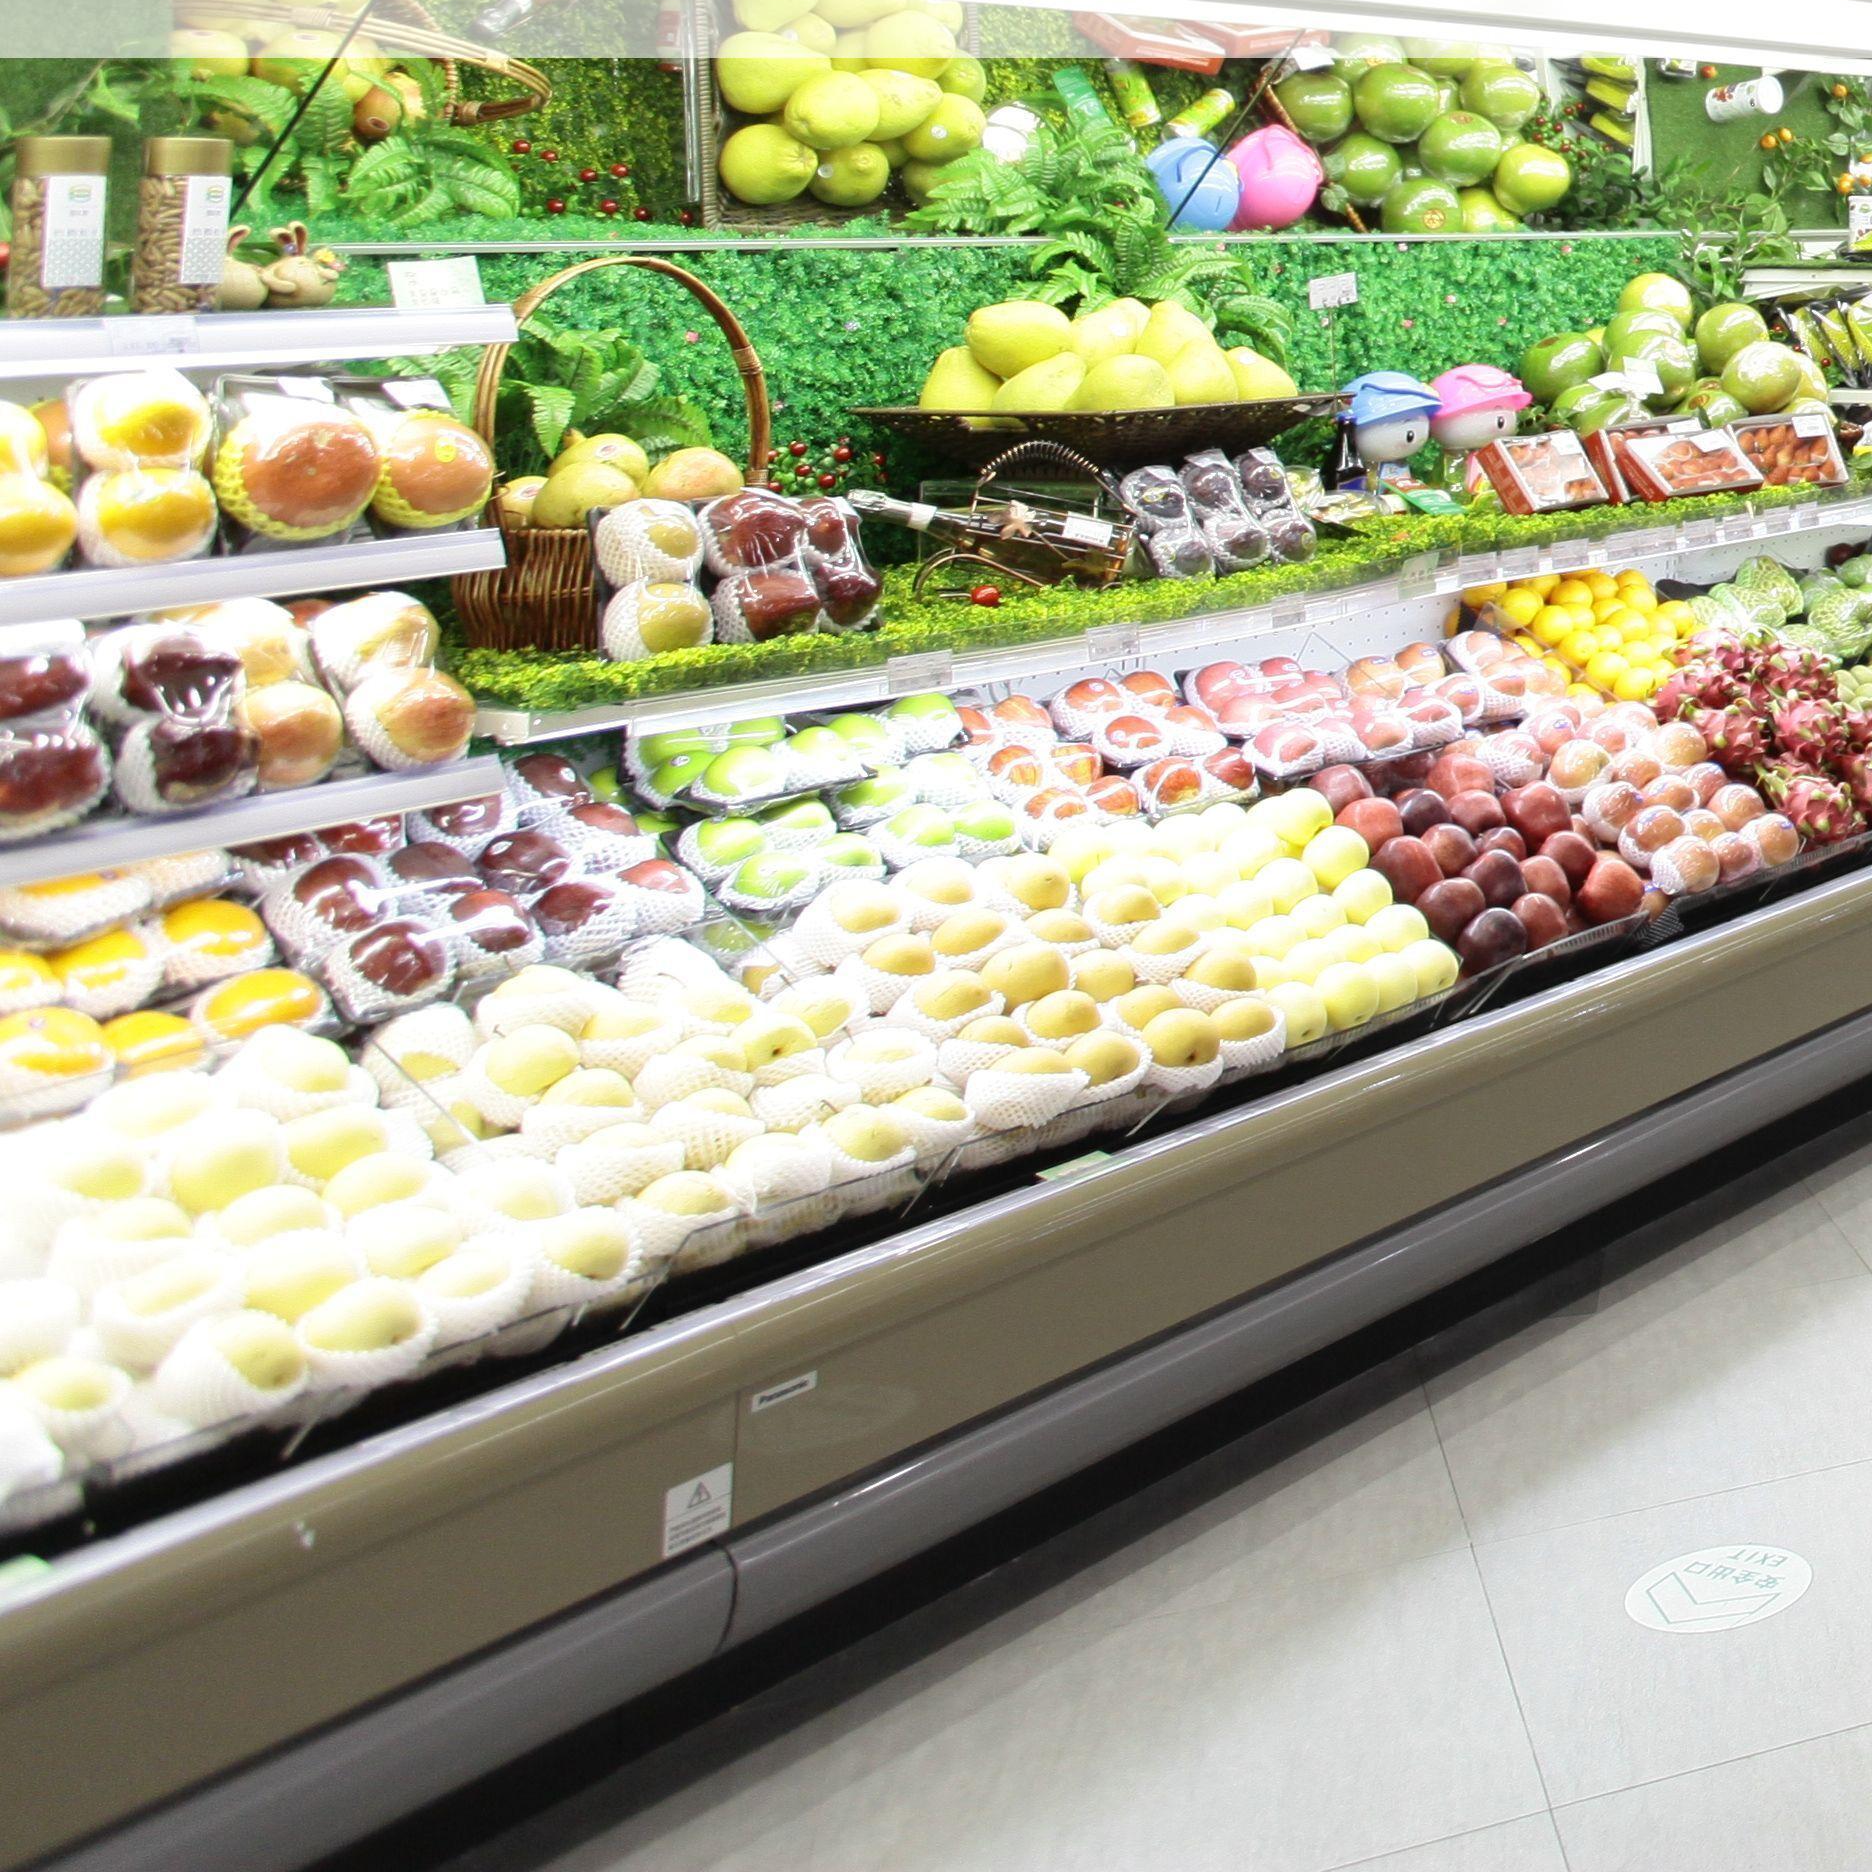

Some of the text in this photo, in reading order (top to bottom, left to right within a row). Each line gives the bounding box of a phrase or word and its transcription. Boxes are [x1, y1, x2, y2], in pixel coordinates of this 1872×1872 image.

[1728, 1548, 1789, 1568] EXIT
[1683, 1561, 1786, 1590] 安全出口
